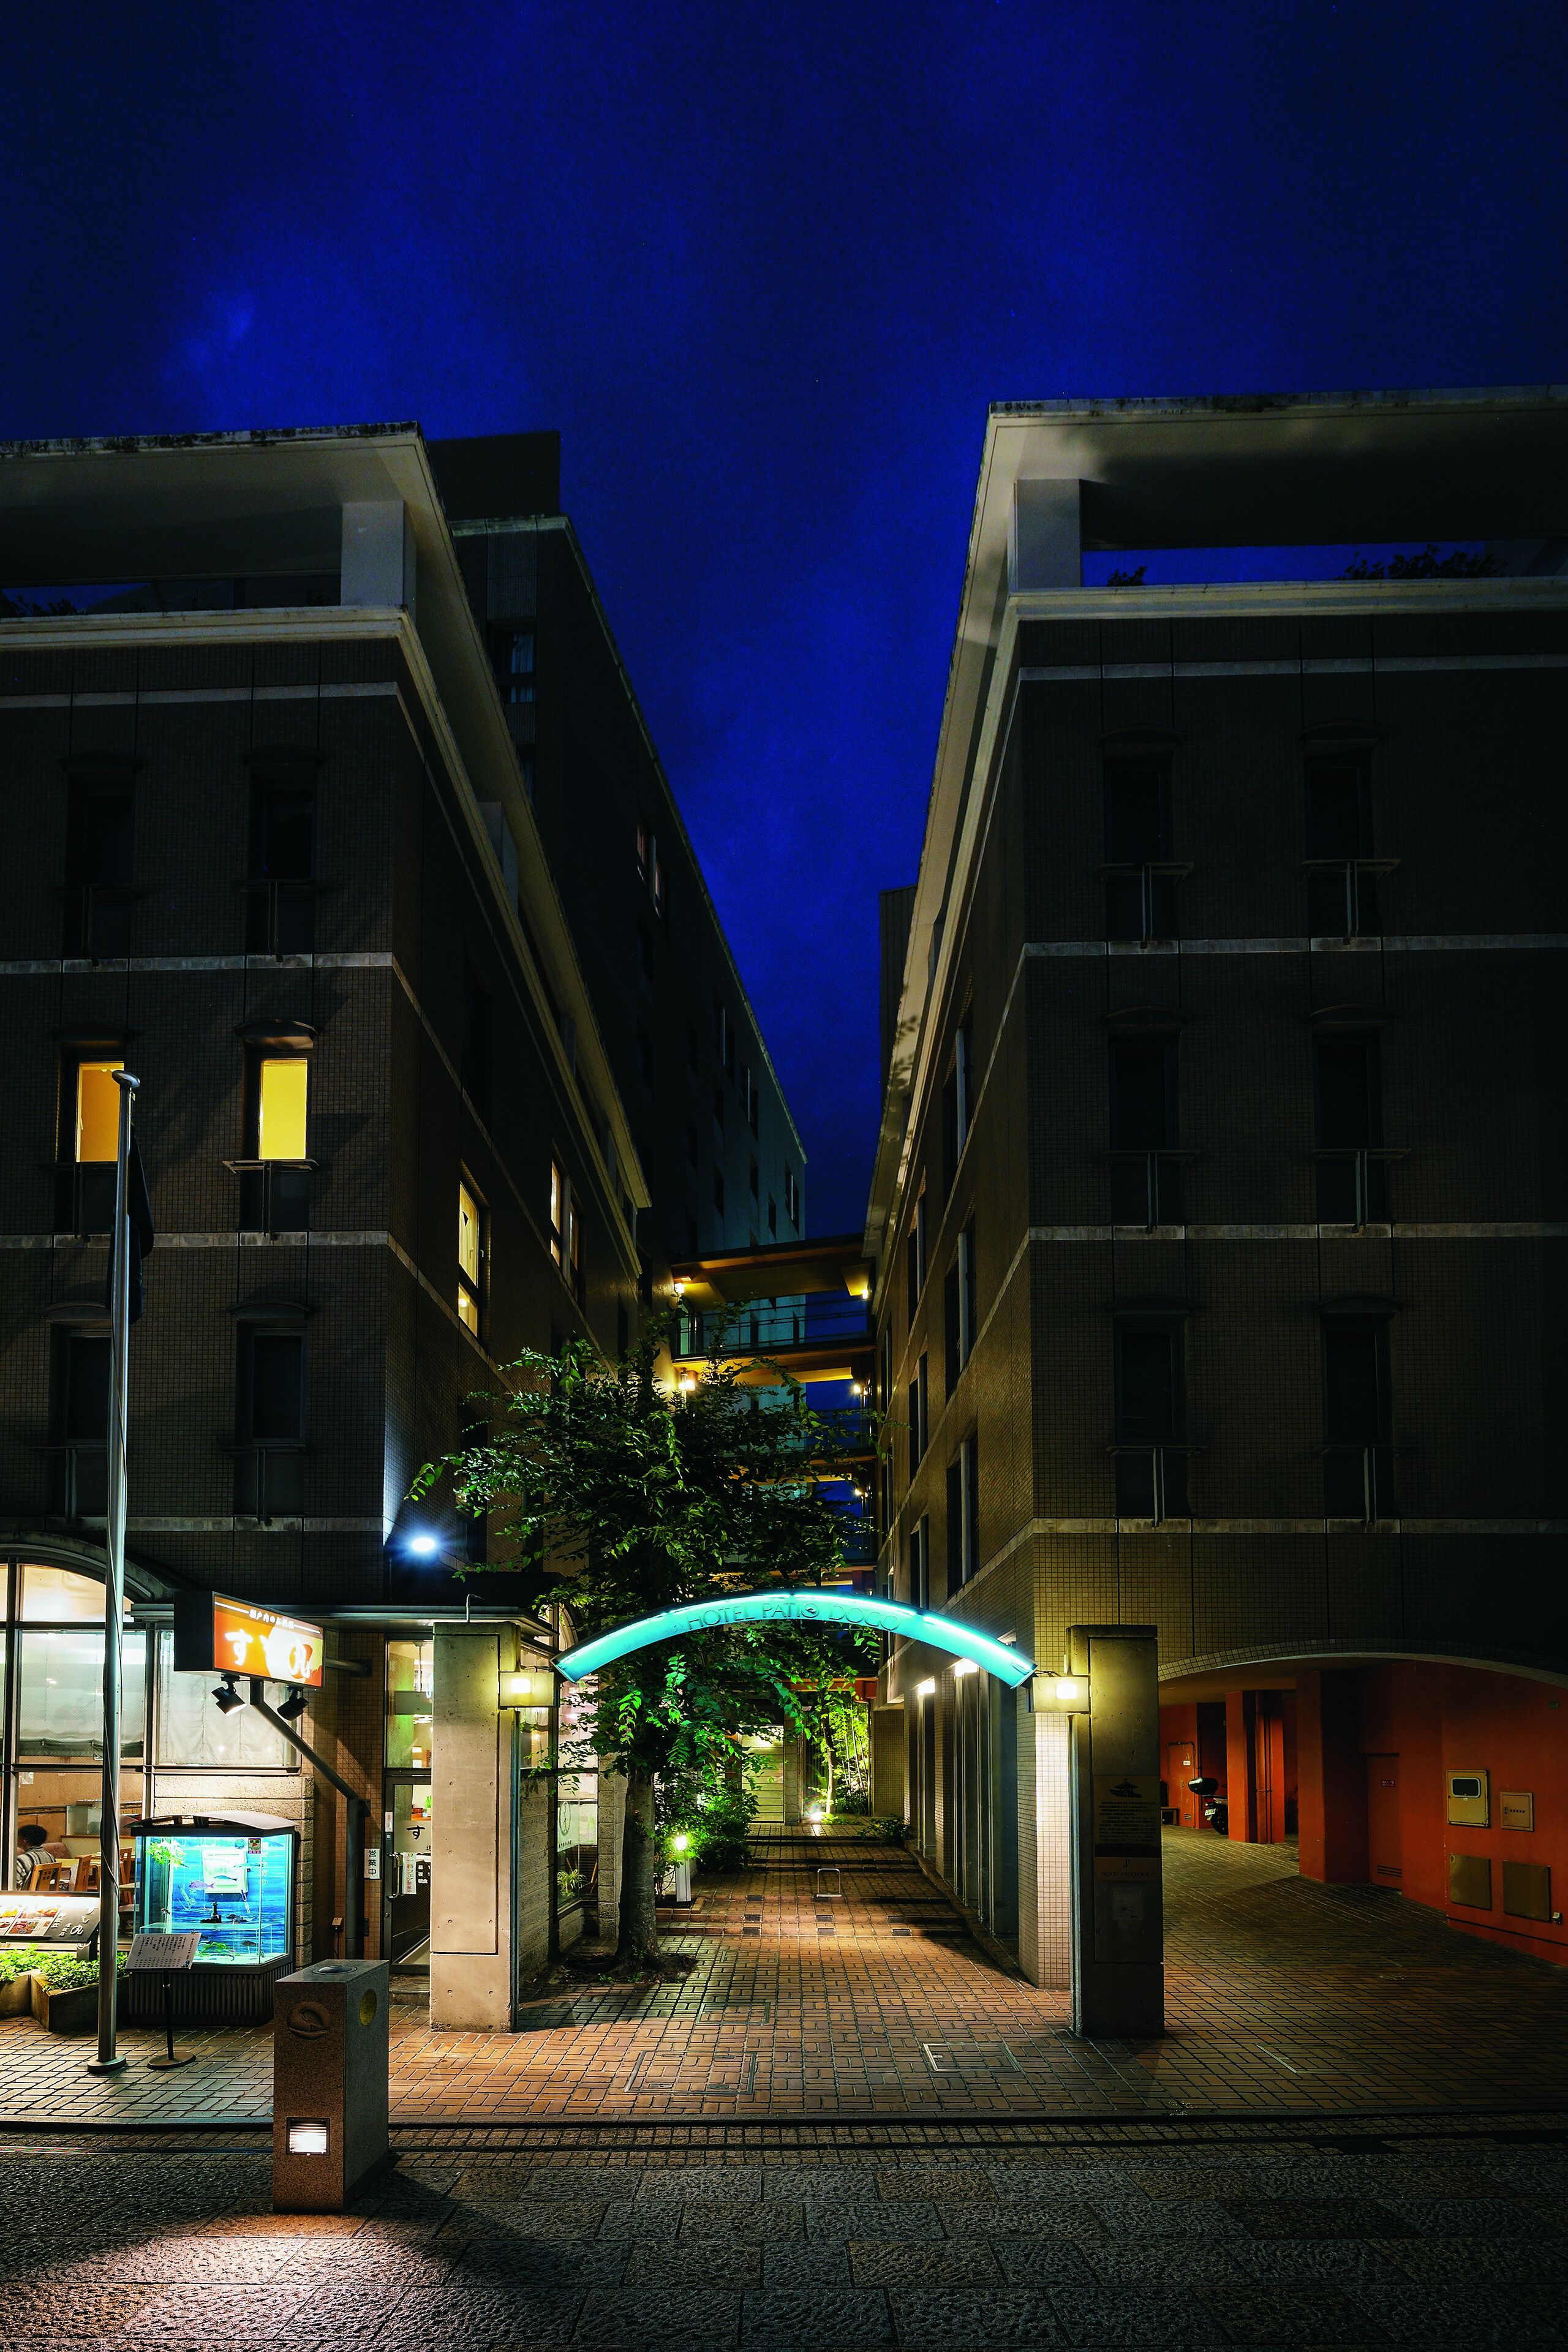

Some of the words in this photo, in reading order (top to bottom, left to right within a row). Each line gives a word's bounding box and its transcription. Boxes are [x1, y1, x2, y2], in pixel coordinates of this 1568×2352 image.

[688, 1605, 755, 1630] HOTEL
[762, 1602, 820, 1619] PATIO
[406, 1825, 426, 1840] す
[368, 1850, 377, 1875] 営業中
